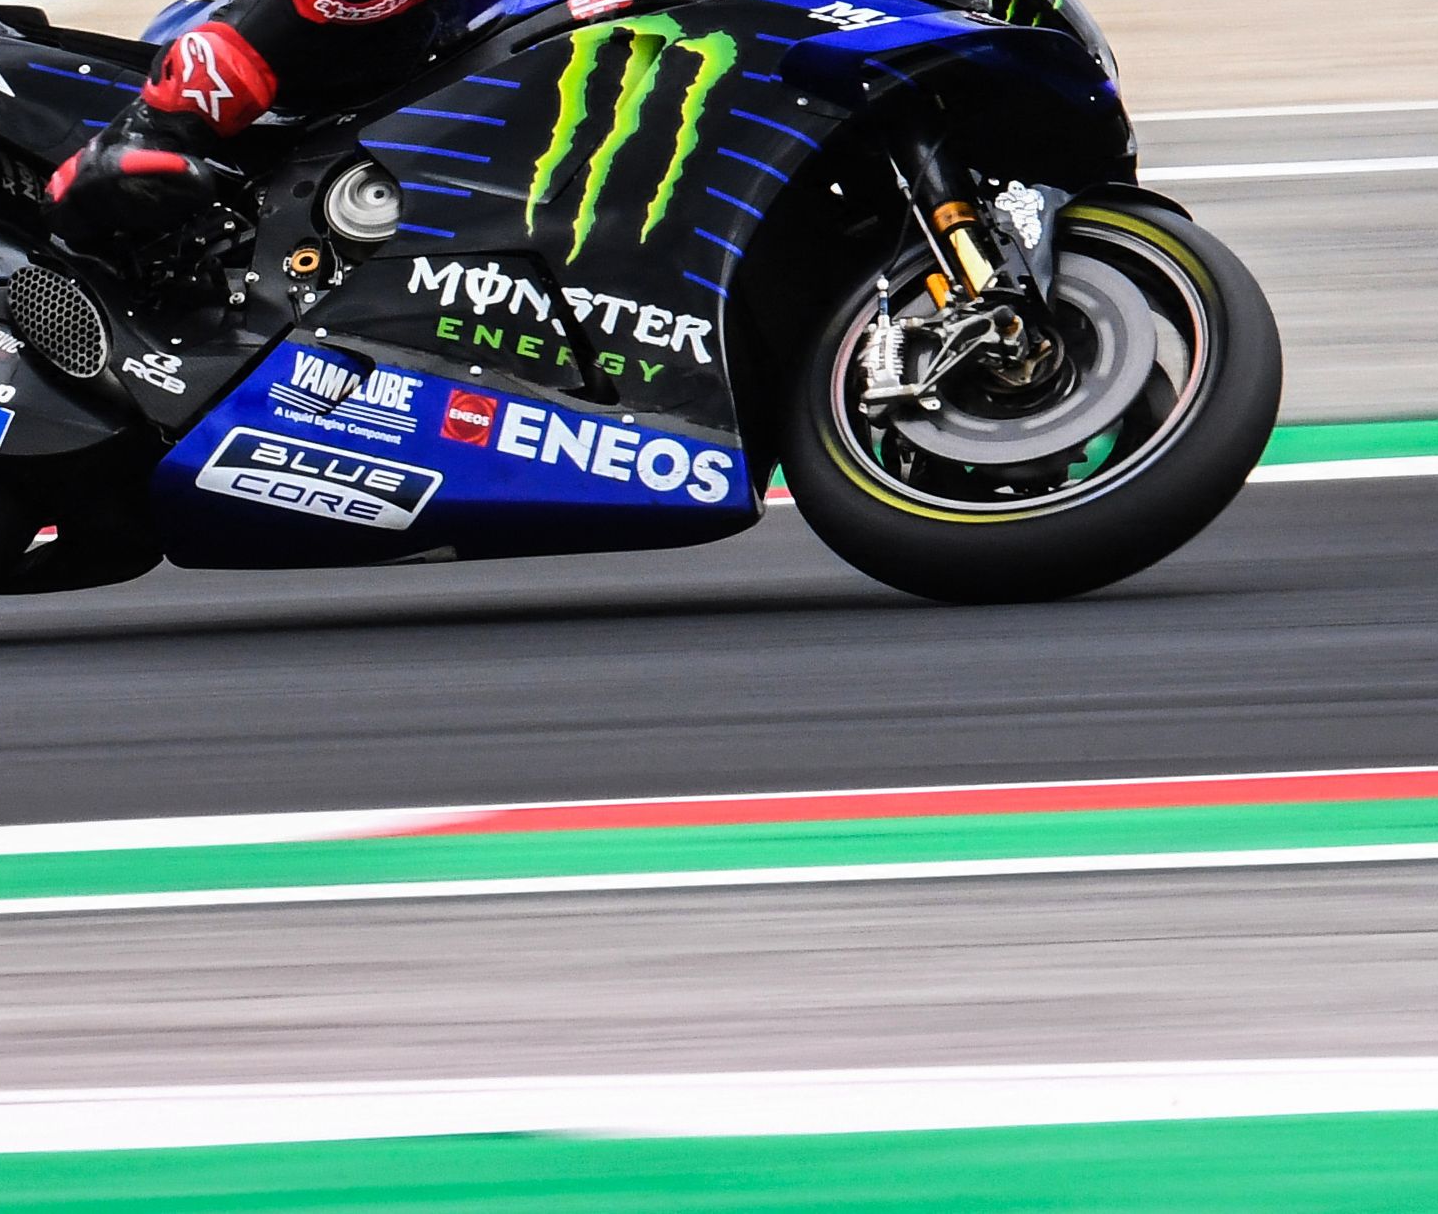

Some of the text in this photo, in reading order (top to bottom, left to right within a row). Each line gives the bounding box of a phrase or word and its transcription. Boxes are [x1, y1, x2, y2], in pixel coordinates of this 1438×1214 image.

[436, 316, 665, 383] ENERGY
[122, 356, 186, 394] RCB
[274, 406, 402, 445] A Liquid Engine Component
[449, 407, 490, 427] ENEOS
[250, 442, 406, 492] BLUE
[496, 402, 733, 503] ENEOS
[231, 473, 383, 521] CORE
